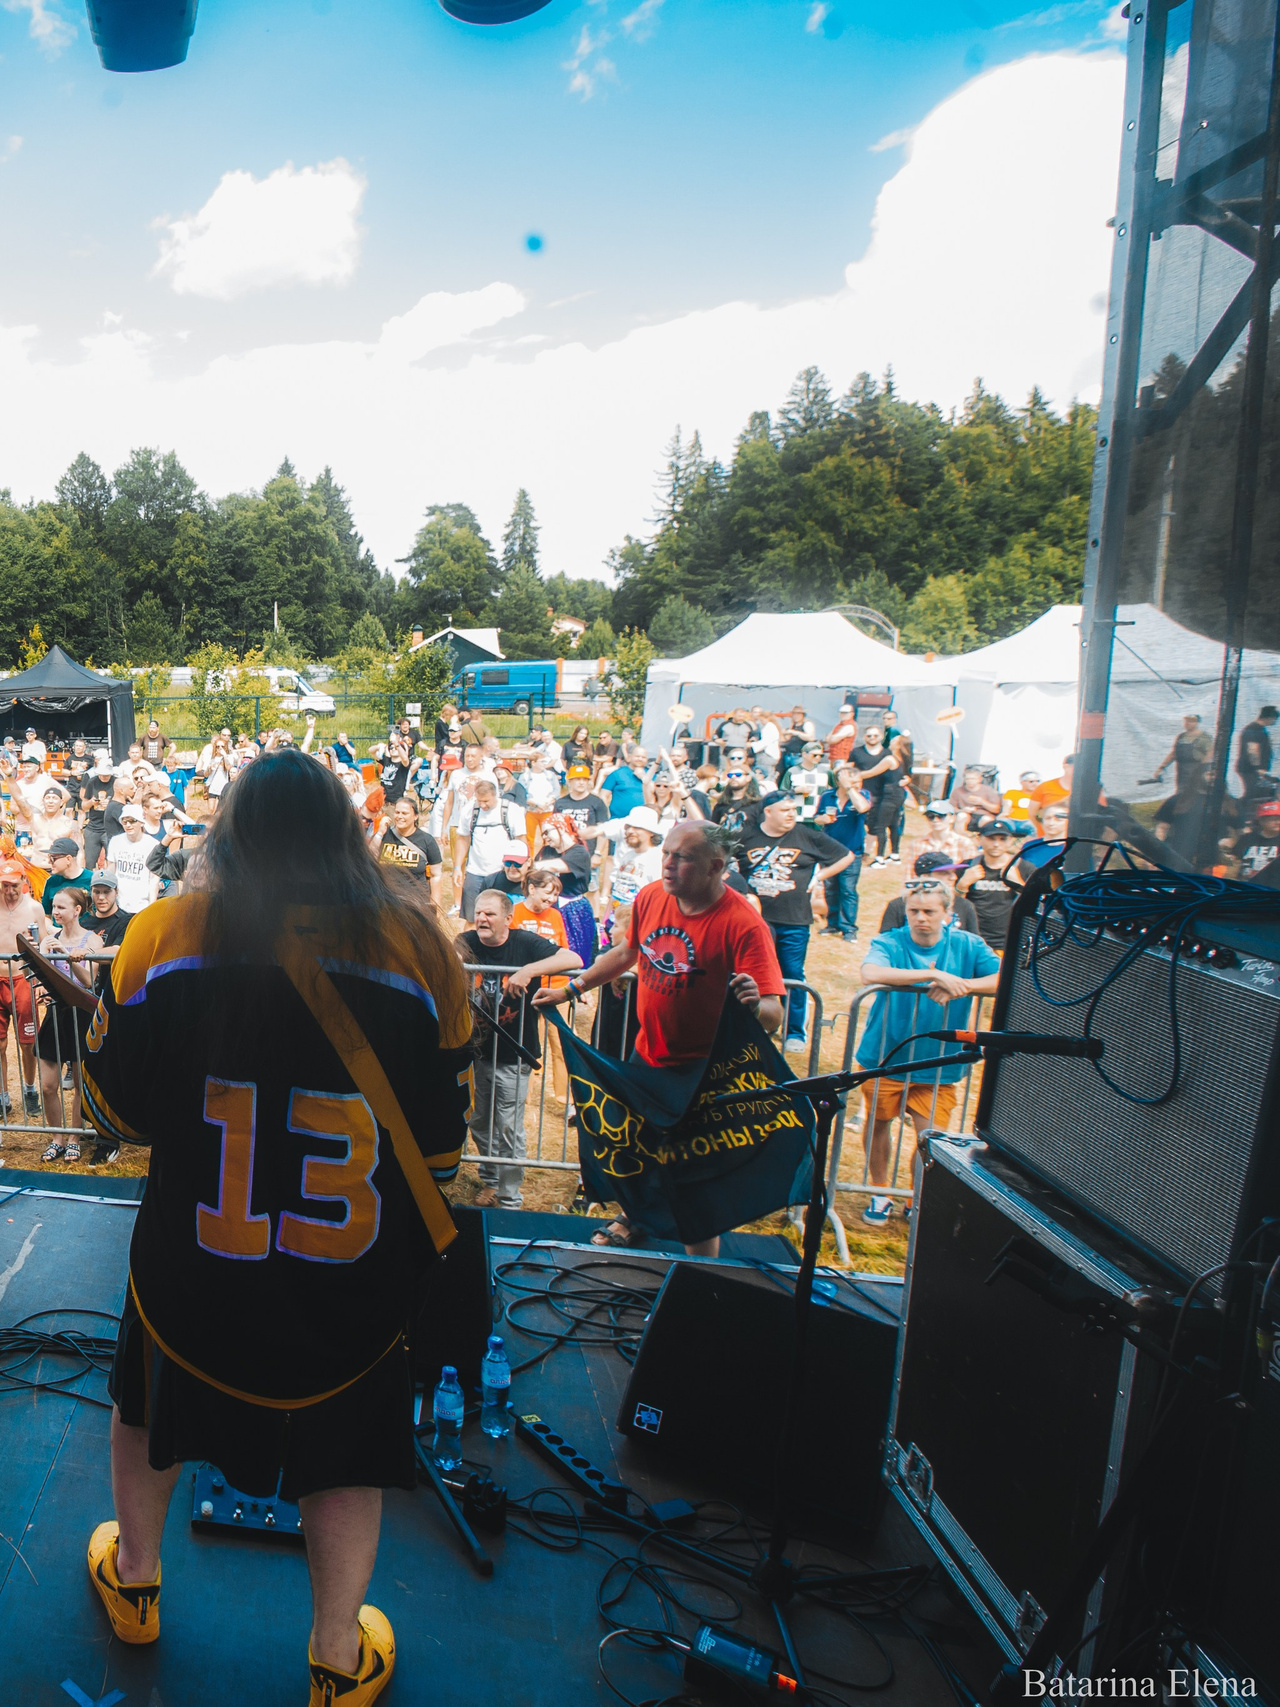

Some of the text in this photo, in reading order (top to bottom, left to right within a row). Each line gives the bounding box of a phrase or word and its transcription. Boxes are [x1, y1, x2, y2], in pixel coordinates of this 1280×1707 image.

[117, 859, 144, 875] ПОХЕР
[1240, 958, 1275, 974] Twin
[1249, 972, 1276, 987] Amp
[196, 1074, 382, 1264] 13
